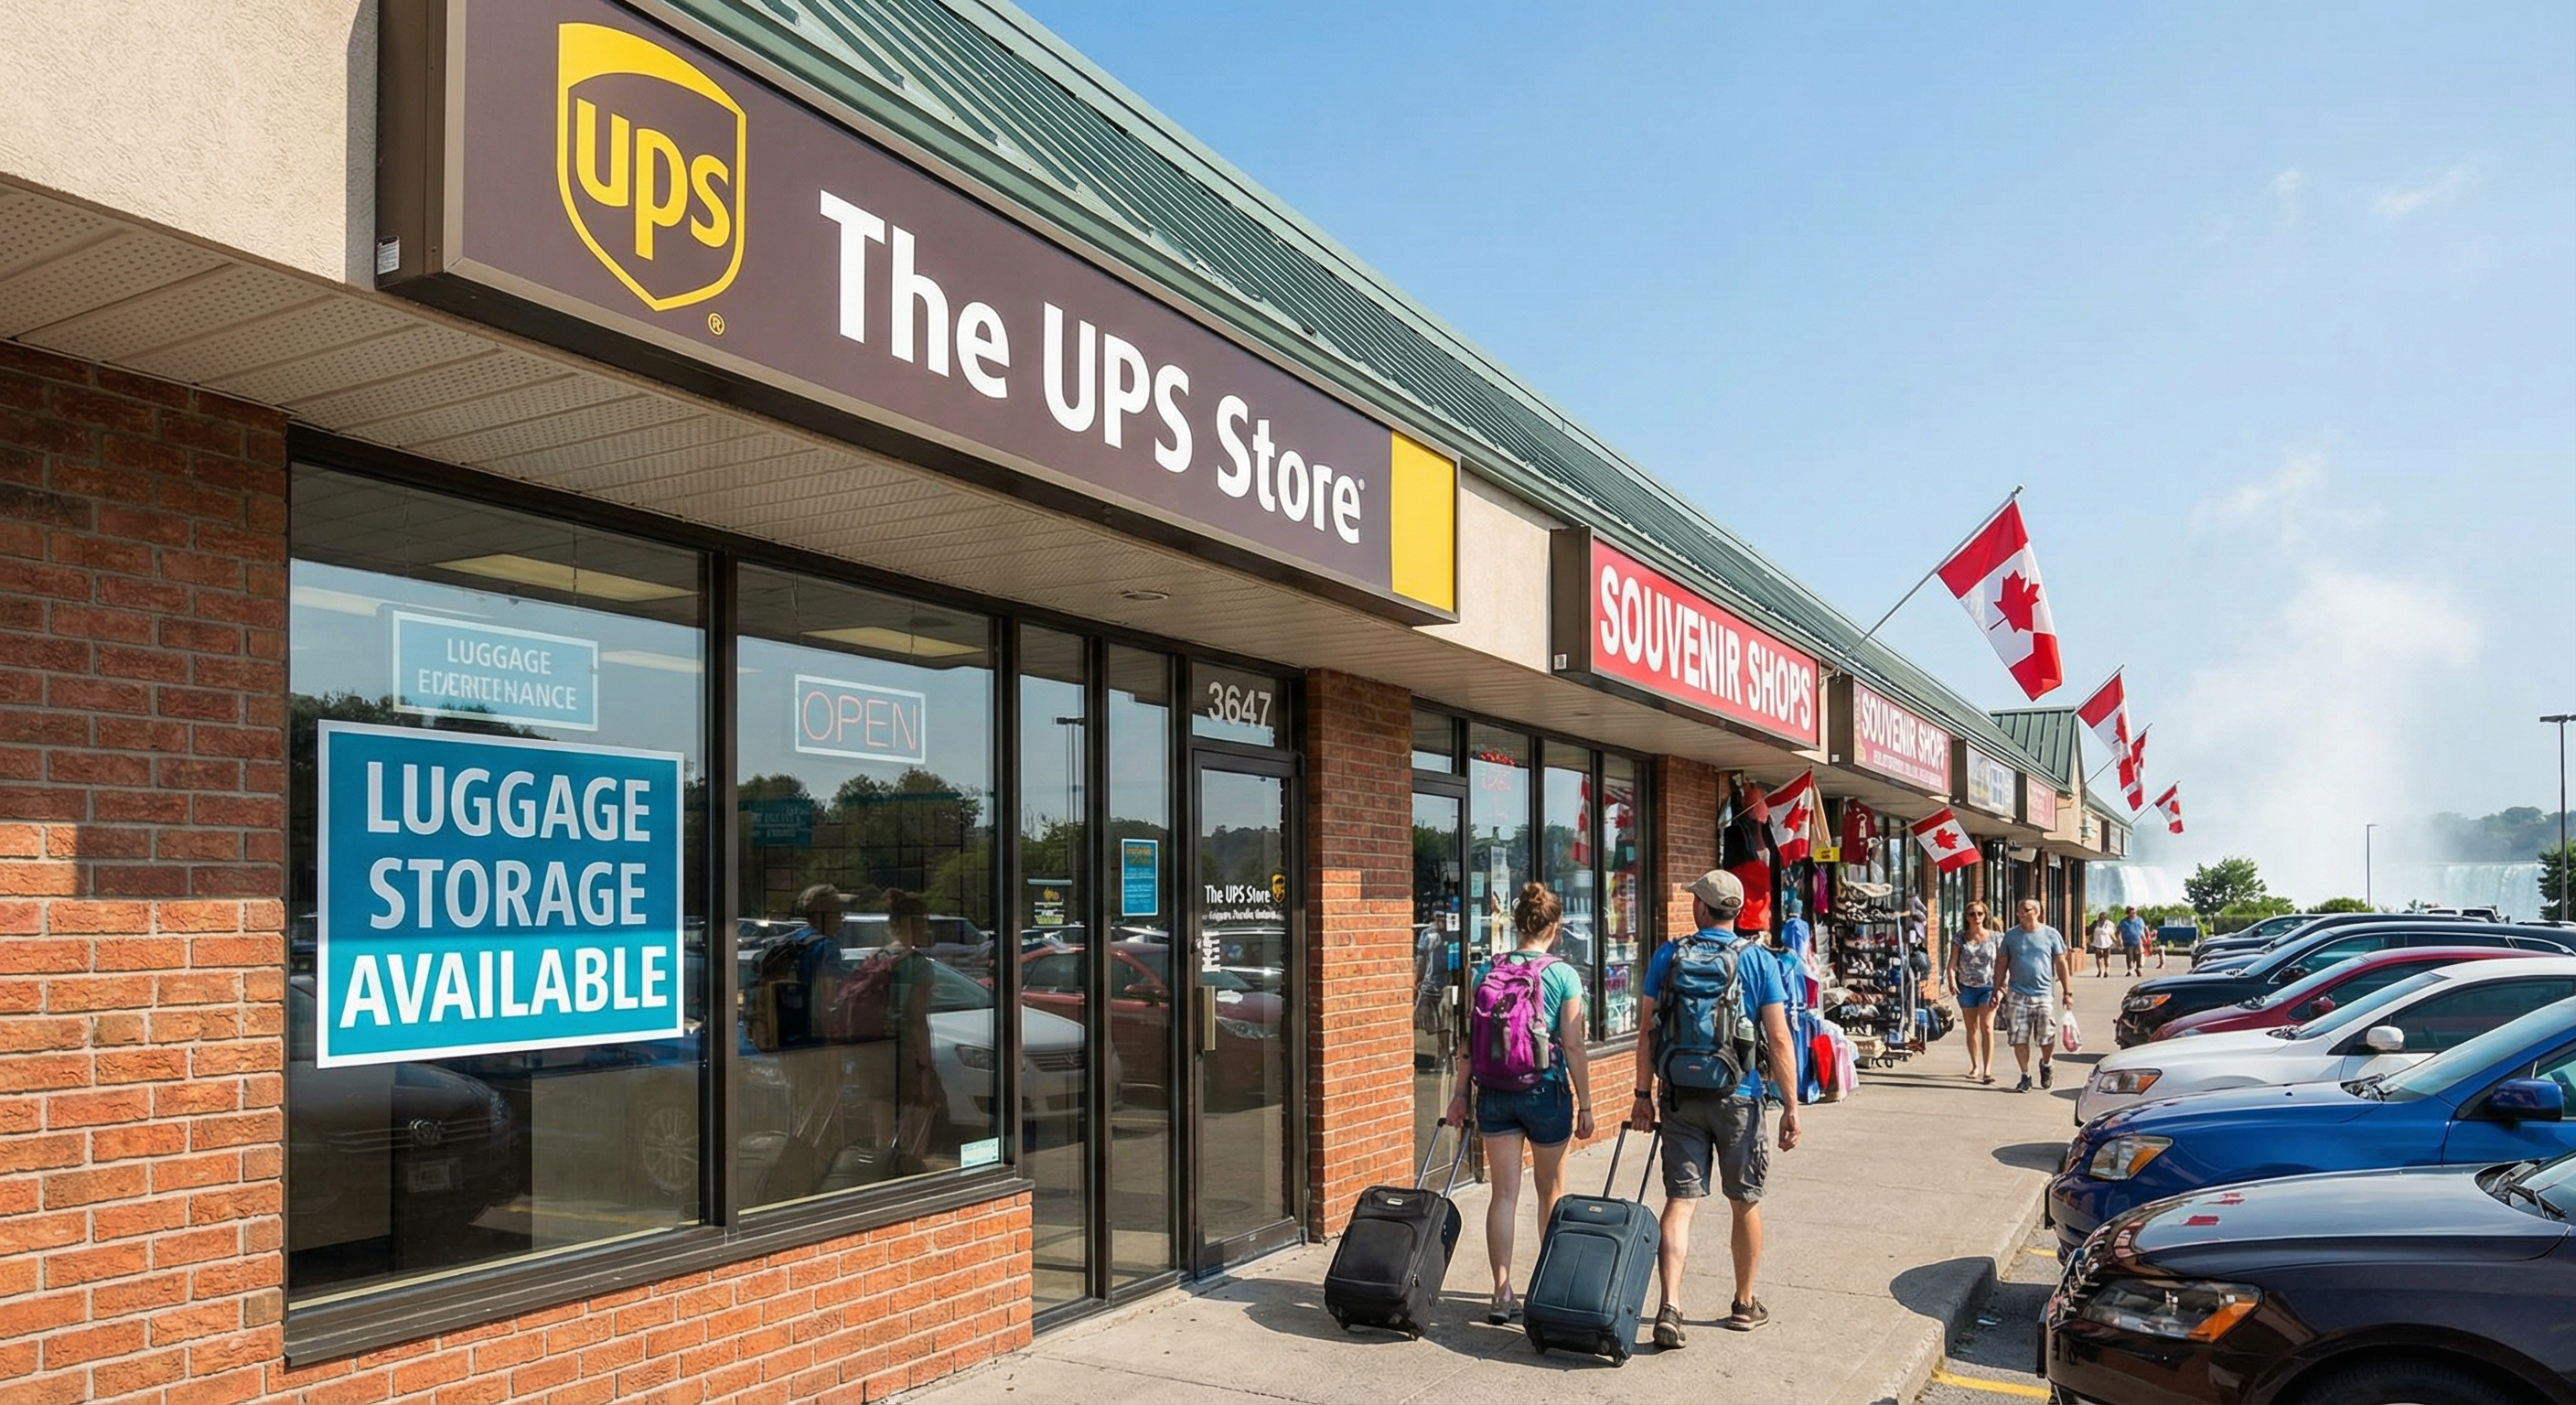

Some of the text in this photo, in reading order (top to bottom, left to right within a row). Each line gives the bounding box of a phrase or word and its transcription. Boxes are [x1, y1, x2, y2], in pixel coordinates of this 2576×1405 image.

[575, 99, 730, 262] ups
[820, 189, 1363, 544] The UPS Store
[446, 638, 553, 676] LUGGAGE
[1599, 564, 1812, 731] SOUVENIR SHOPS
[802, 691, 917, 751] OPEN
[1208, 681, 1272, 728] 3647
[1862, 692, 1916, 759] SOUVENIR
[367, 760, 651, 842] LUGGAGE
[369, 856, 648, 930] STORAGE
[1205, 885, 1223, 904] The
[1225, 885, 1245, 904] UPS
[338, 945, 668, 1029] AVAILABLE
